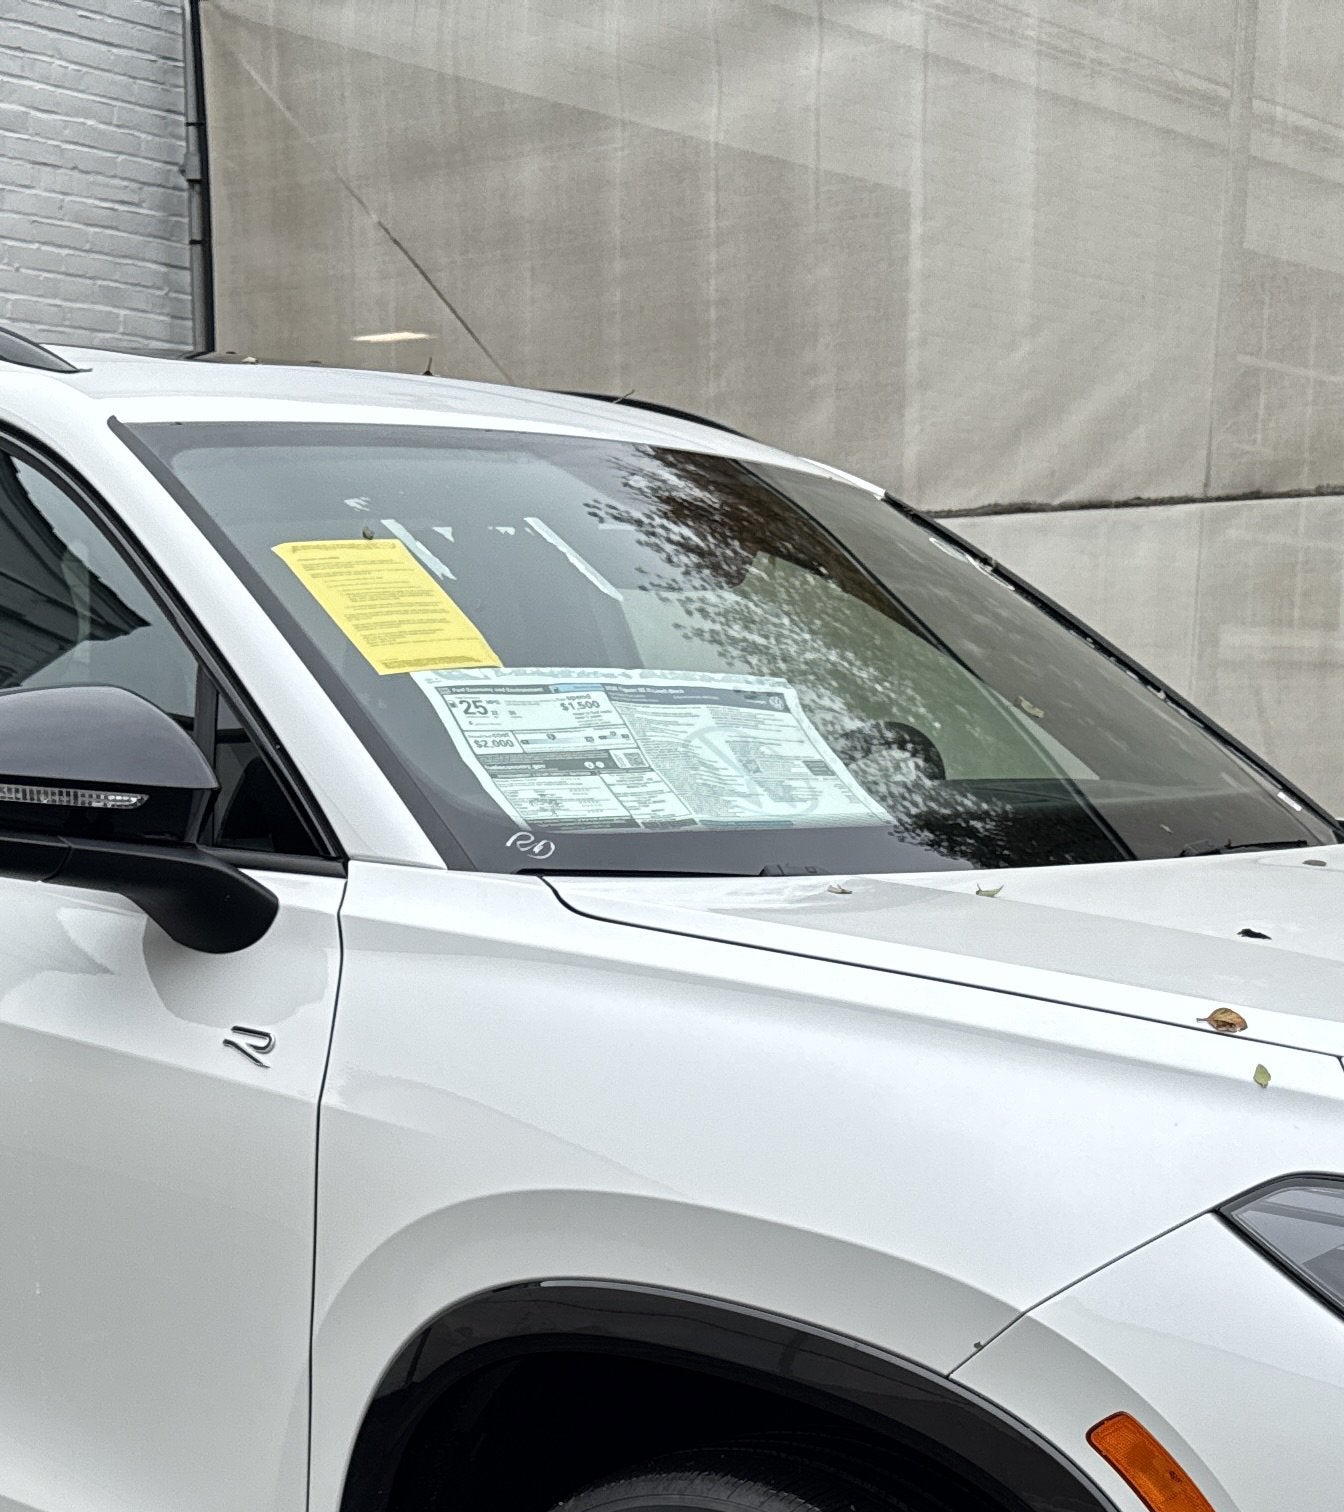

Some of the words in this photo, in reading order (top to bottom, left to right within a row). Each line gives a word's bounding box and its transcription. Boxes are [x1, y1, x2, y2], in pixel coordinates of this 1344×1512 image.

[458, 700, 488, 715] 25
[560, 700, 600, 712] $1,500
[473, 738, 515, 750] $2,000
